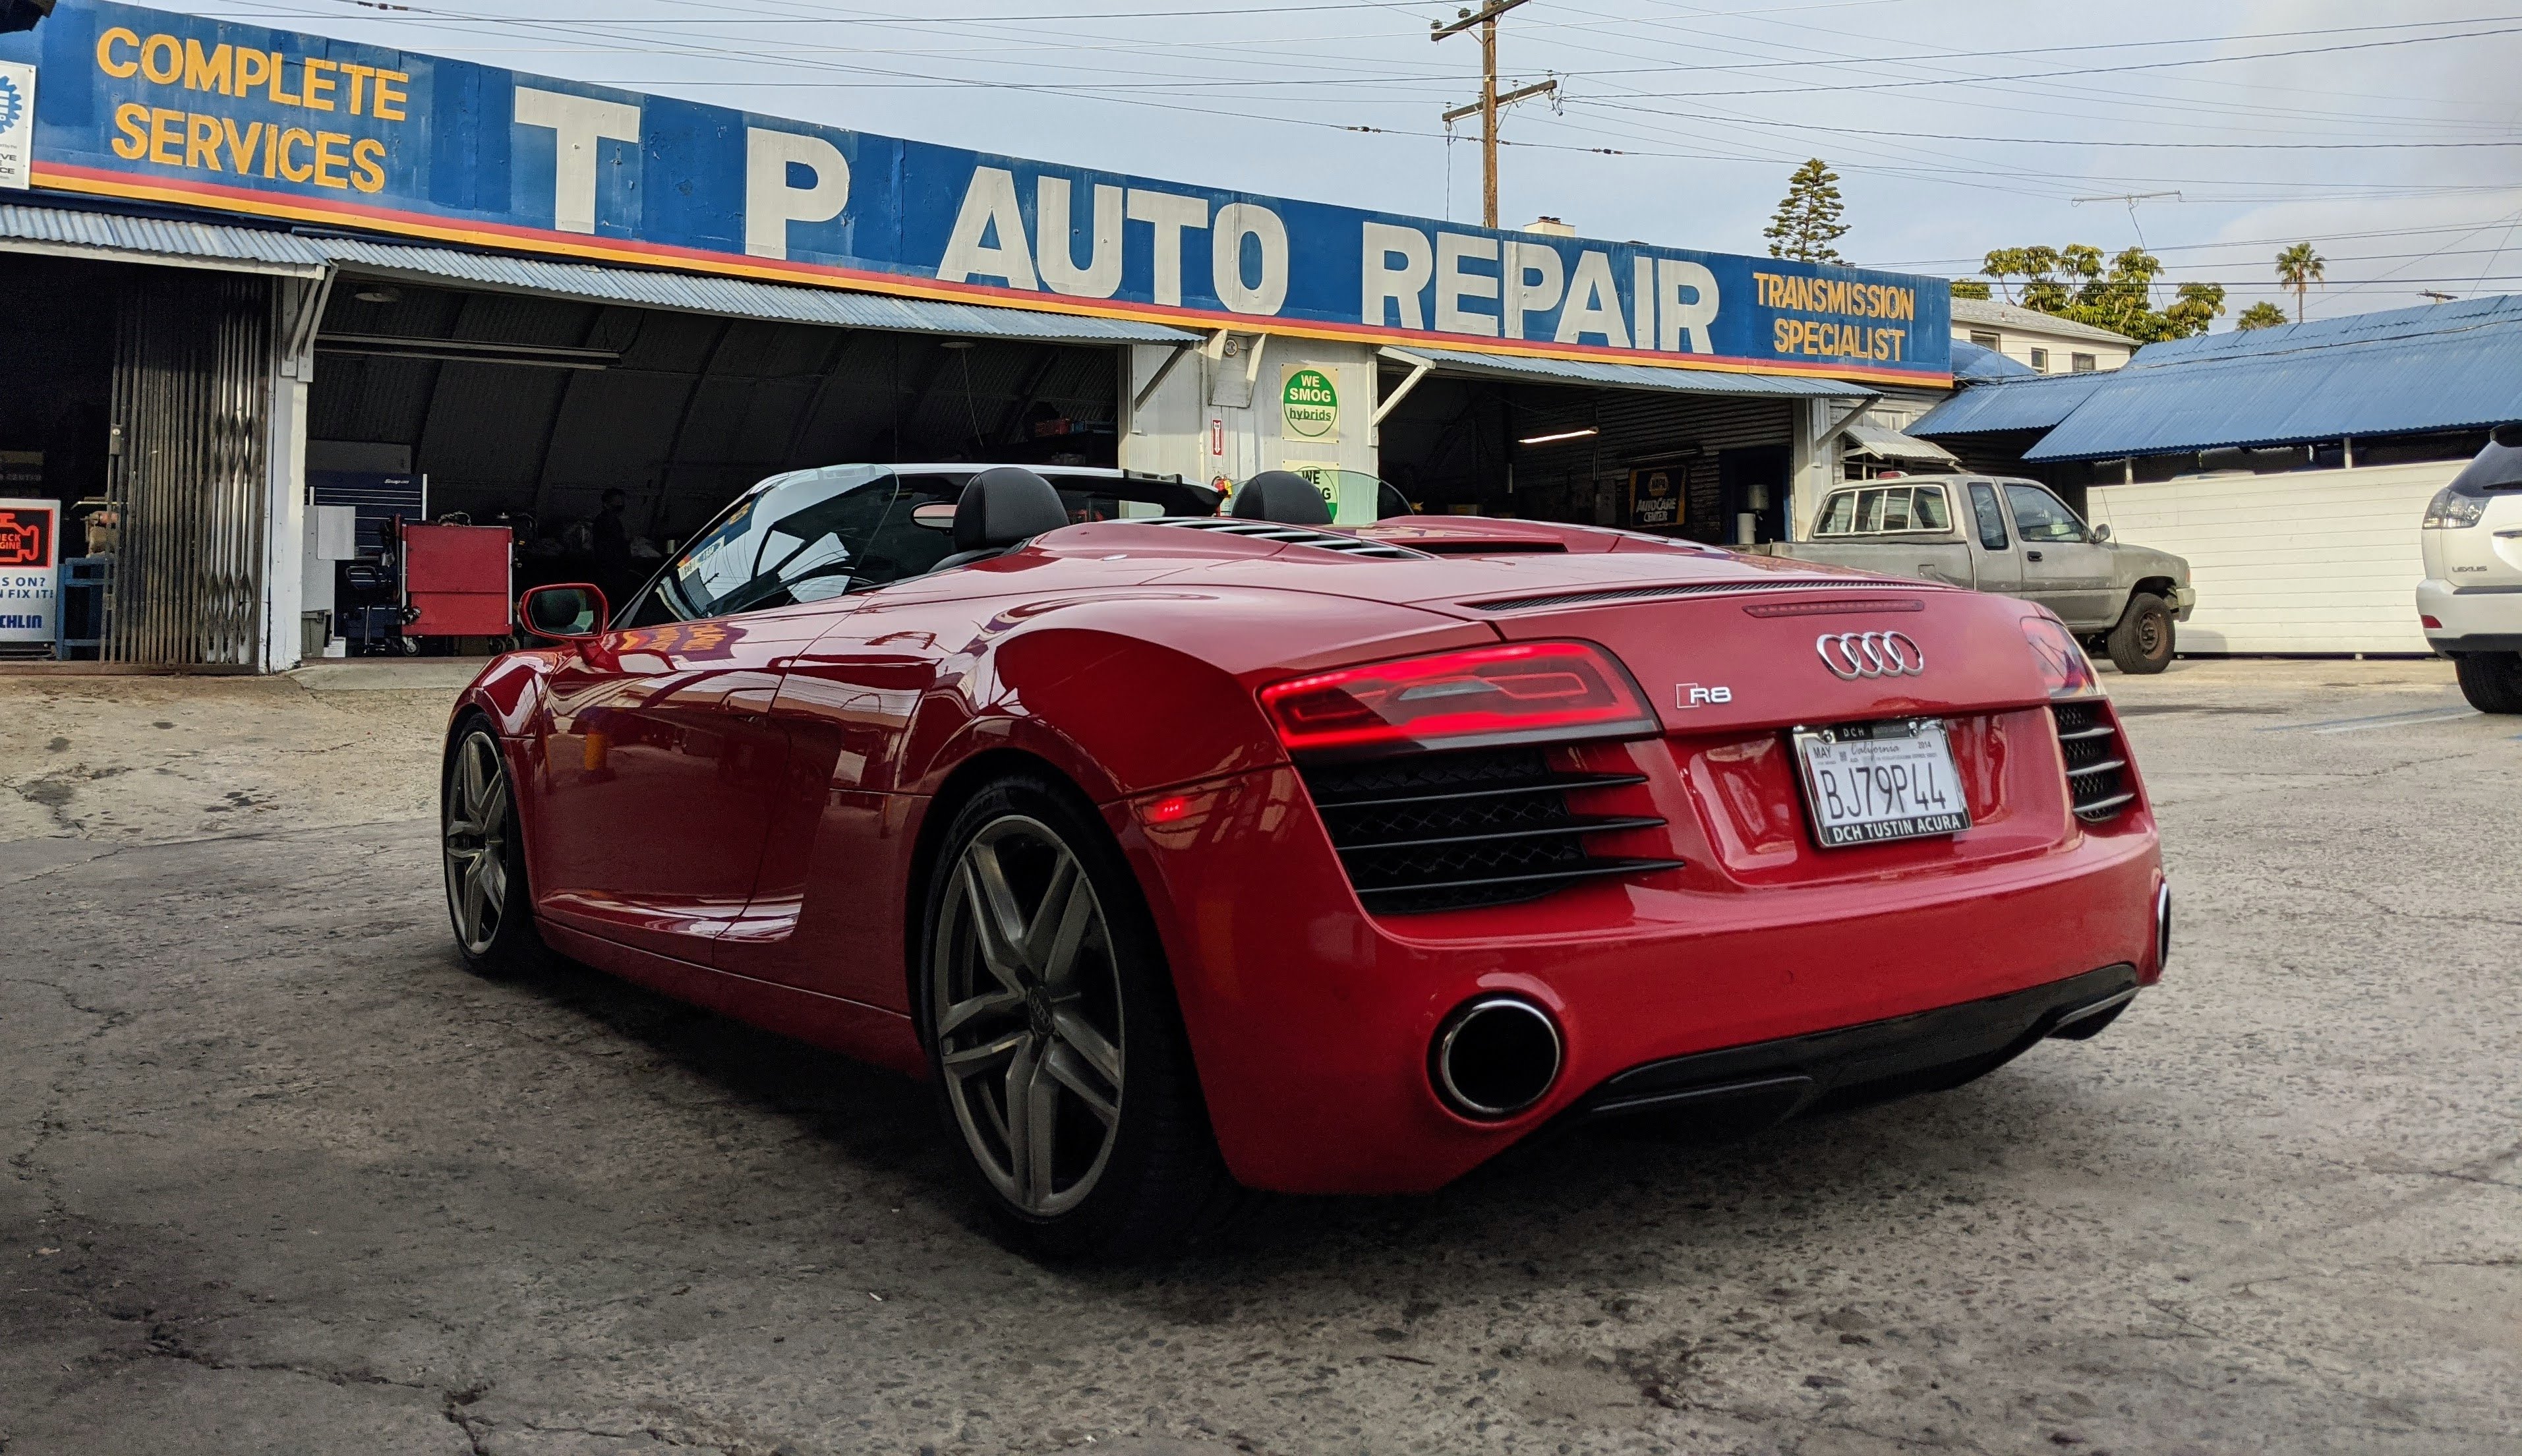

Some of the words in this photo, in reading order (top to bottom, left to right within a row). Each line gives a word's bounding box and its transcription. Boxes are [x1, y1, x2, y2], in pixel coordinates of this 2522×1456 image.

[97, 27, 409, 121] COMPLETE
[111, 103, 386, 193] SERVICES
[515, 85, 641, 234] T
[745, 126, 851, 260] P
[935, 165, 1289, 316] AUTO
[1362, 221, 1720, 355] REPAIR
[1753, 272, 1915, 321] TRANSMISSION
[1774, 317, 1906, 362] SPECIALIST
[1301, 374, 1320, 388] WE
[1289, 388, 1332, 403] SMOG
[1289, 407, 1332, 421] hybrids
[0, 533, 21, 542] ECK
[15, 577, 46, 587] ON?
[9, 589, 30, 598] FIX
[36, 589, 54, 598] IT!
[1689, 687, 1732, 704] R8
[1843, 728, 1865, 738] DCH
[1813, 745, 1832, 759] MAY
[1850, 741, 1899, 761] California
[1918, 741, 1931, 749] 2014
[1820, 762, 1946, 819] BJ79P44
[1832, 827, 1862, 842] DCH
[1864, 819, 1914, 839] TUSTIN
[1918, 814, 1961, 832] ACURA
